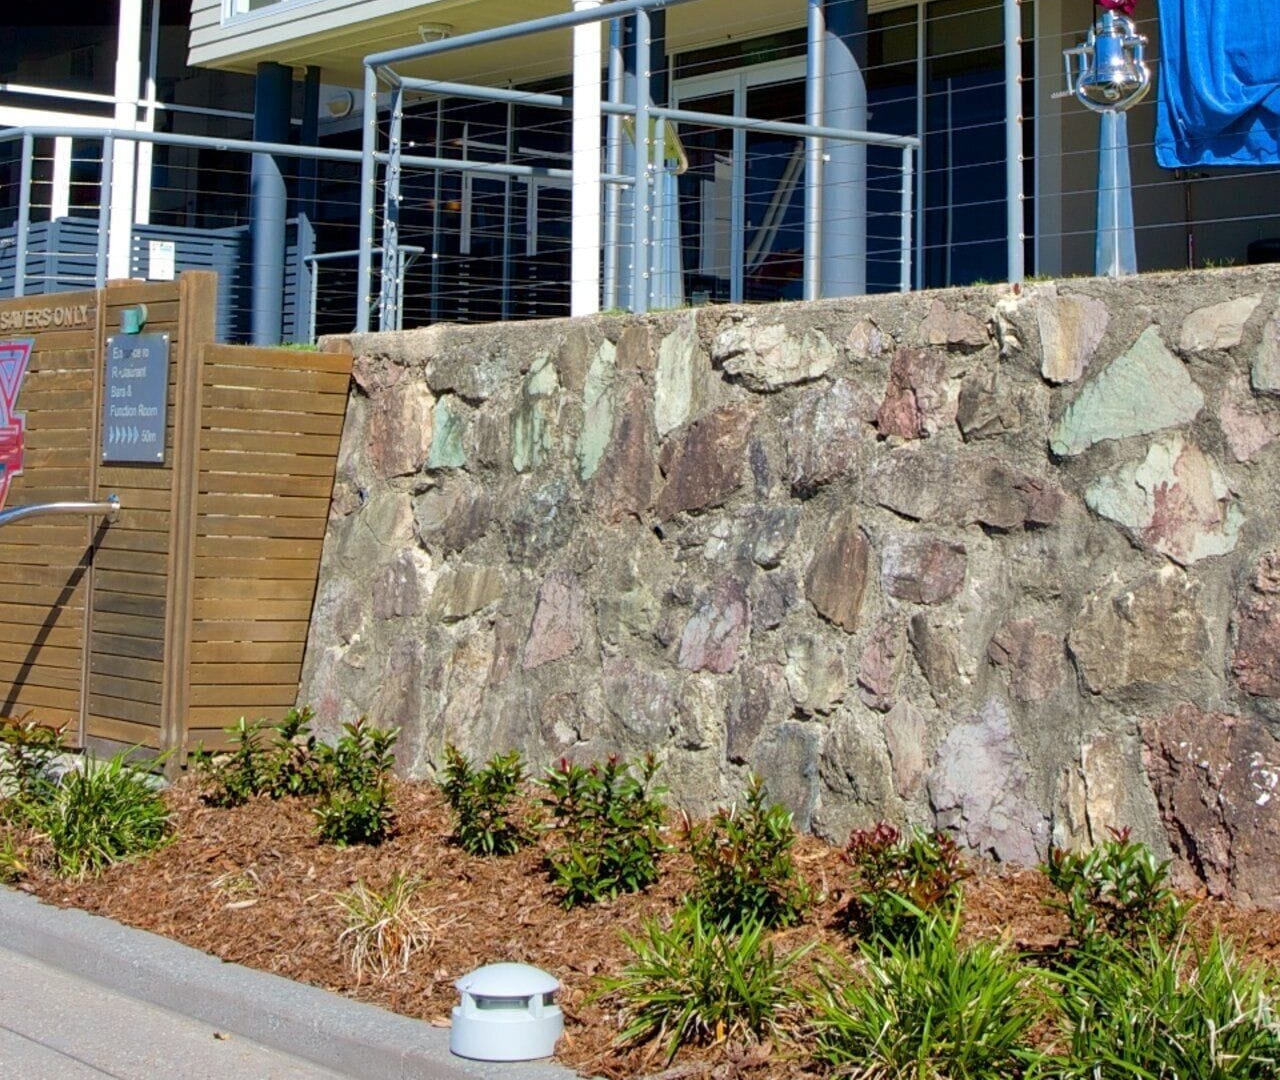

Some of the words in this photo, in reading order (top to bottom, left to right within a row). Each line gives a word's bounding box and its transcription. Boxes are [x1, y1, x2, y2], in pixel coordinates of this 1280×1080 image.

[0, 308, 51, 331] SAVERS
[51, 304, 89, 328] ONLY
[110, 404, 137, 417] Function
[138, 403, 158, 417] Room
[141, 429, 157, 443] 50m
